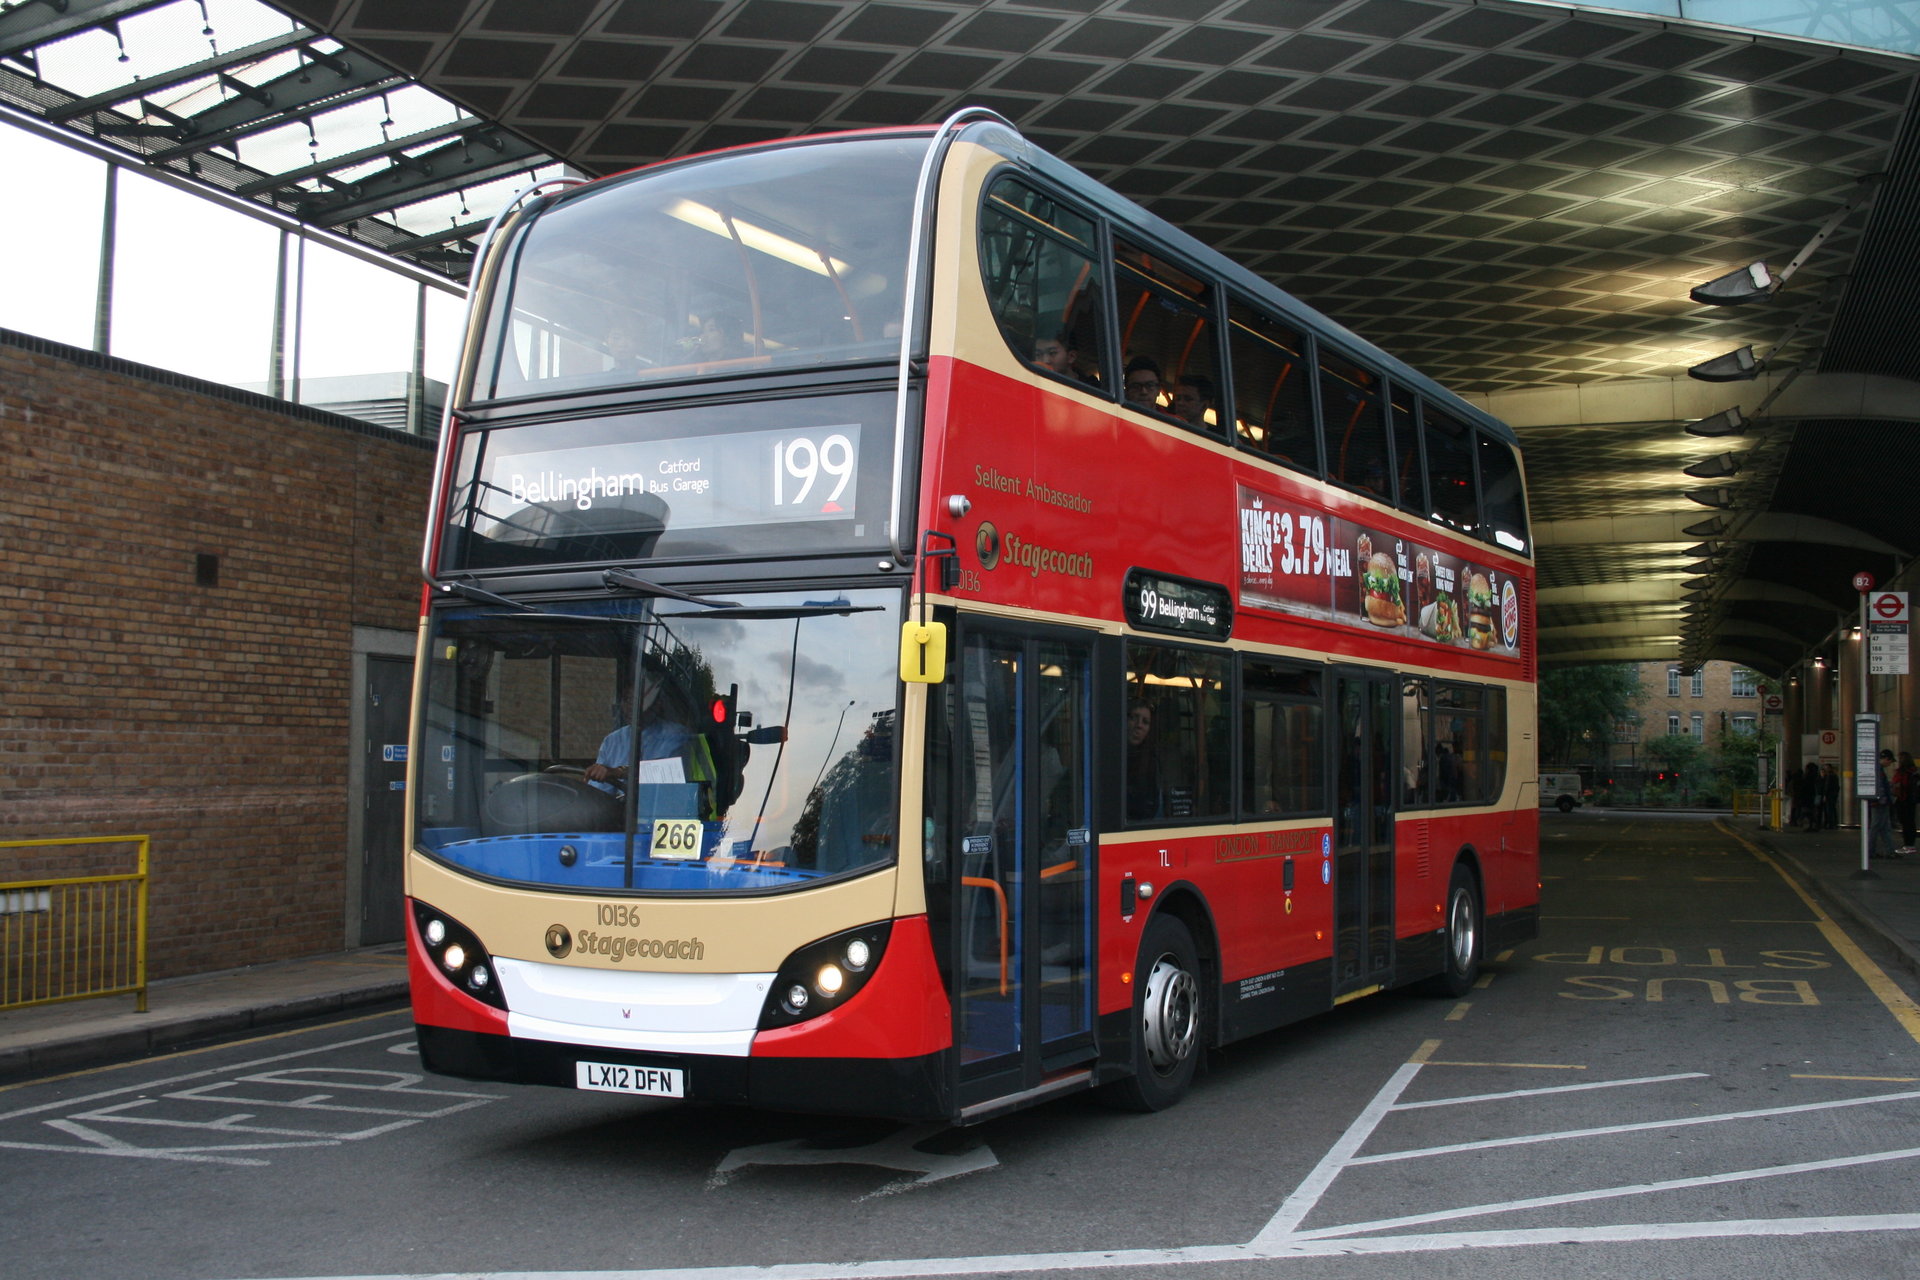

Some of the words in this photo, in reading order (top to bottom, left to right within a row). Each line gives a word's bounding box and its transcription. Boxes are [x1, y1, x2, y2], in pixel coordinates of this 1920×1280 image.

[658, 458, 701, 475] Catford
[774, 433, 855, 506] 199
[510, 467, 644, 510] Bellingham
[650, 479, 669, 494] Bus
[672, 477, 710, 495] Garage
[975, 464, 1021, 496] Selkent
[1026, 478, 1093, 514] Ambassador
[1241, 508, 1272, 547] KING
[1004, 531, 1093, 579] Stagecoach
[1273, 512, 1326, 575] £3.79
[1242, 544, 1274, 574] DEALS
[1326, 547, 1352, 577] MEAL
[957, 568, 981, 592] 0136
[1856, 577, 1870, 586] B2
[1159, 598, 1200, 624] Bellingham
[654, 823, 697, 850] 266
[1215, 836, 1260, 863] LONDON
[1265, 830, 1318, 852] TRANSPORT
[1159, 849, 1170, 867] TL
[597, 903, 641, 928] 10136
[576, 929, 705, 963] Stagecoach
[1531, 945, 1833, 969] STOP
[1557, 975, 1822, 1006] BUS
[586, 1065, 629, 1088] LX12
[635, 1069, 673, 1093] DFN
